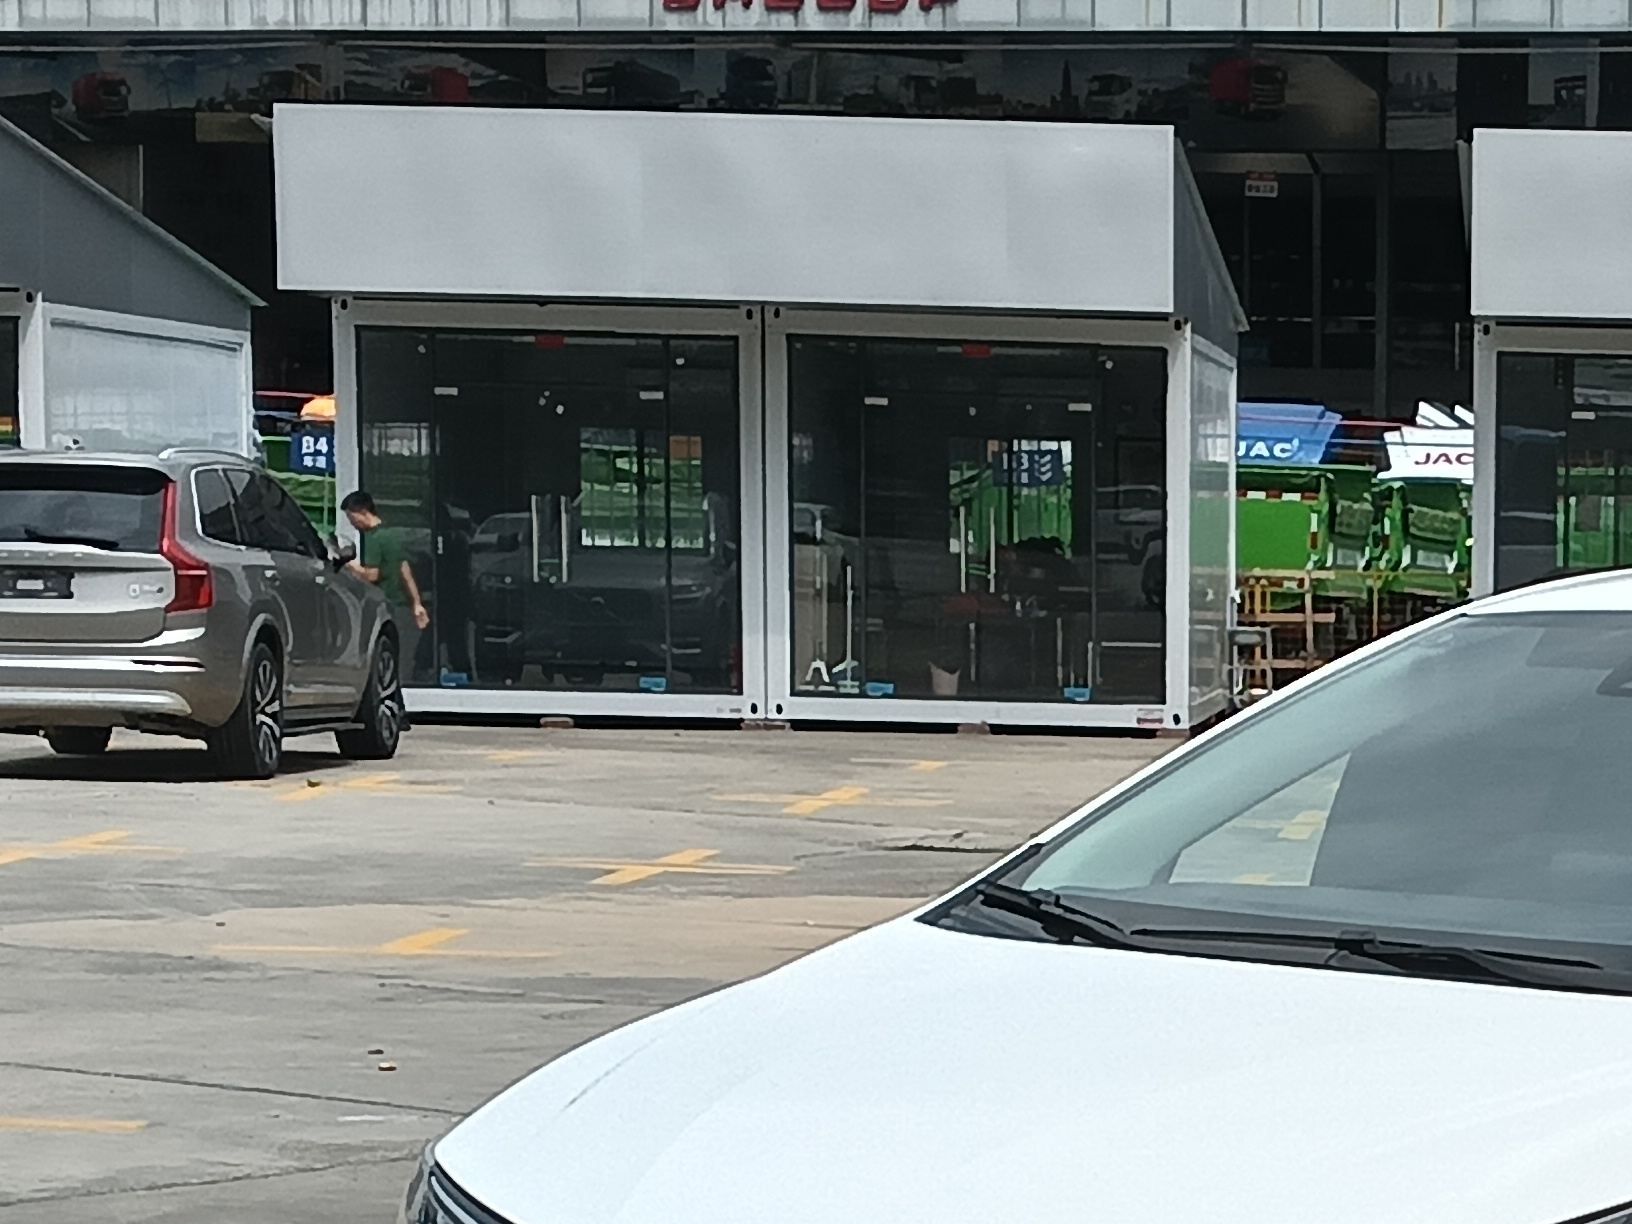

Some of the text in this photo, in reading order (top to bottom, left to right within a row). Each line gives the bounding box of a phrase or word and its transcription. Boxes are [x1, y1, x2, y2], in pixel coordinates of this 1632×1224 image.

[302, 436, 328, 454] B4
[1237, 440, 1293, 458] JAC
[1414, 452, 1474, 465] JAC
